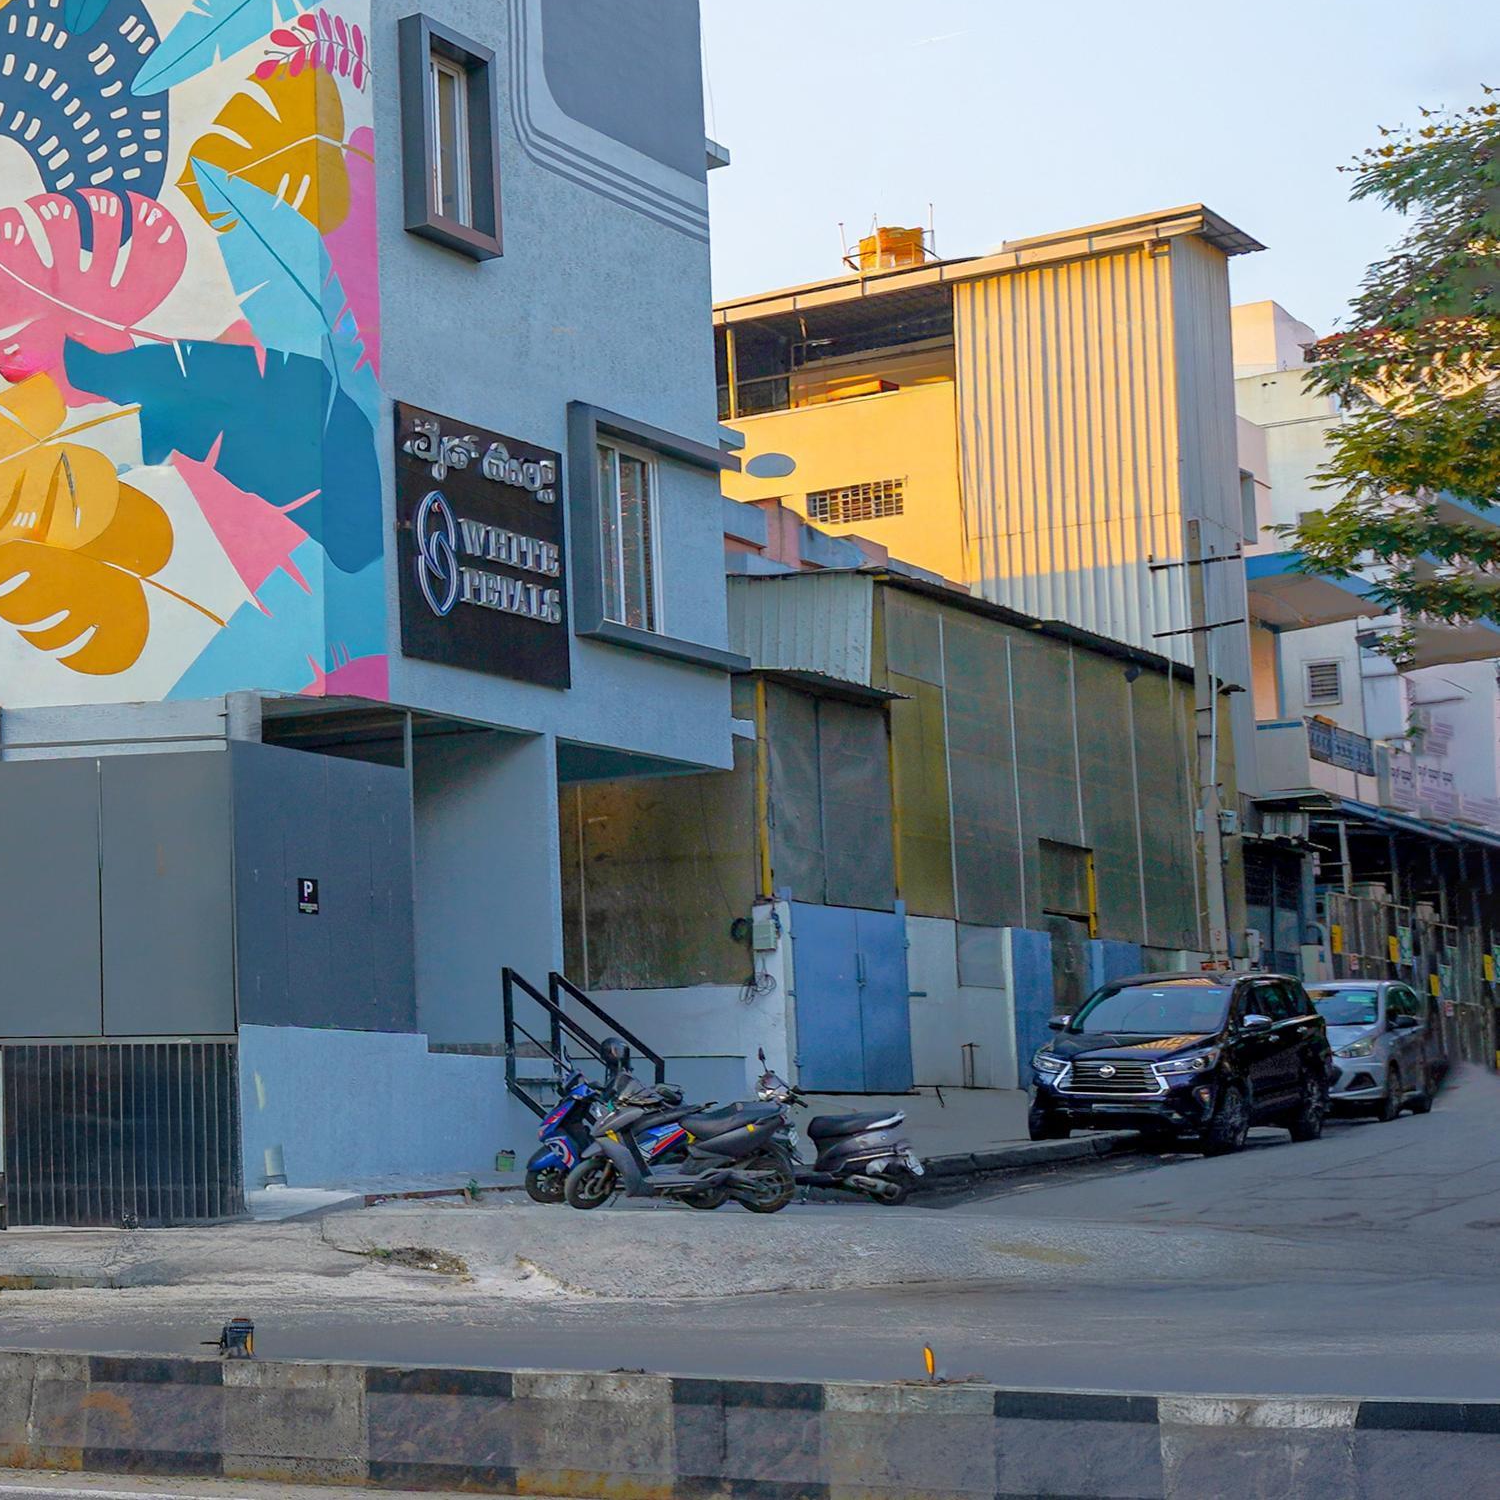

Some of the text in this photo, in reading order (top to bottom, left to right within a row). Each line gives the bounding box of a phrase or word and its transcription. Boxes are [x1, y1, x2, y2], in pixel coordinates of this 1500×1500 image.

[457, 517, 560, 578] WHITE
[459, 566, 562, 624] PETALS
[304, 880, 313, 898] P
